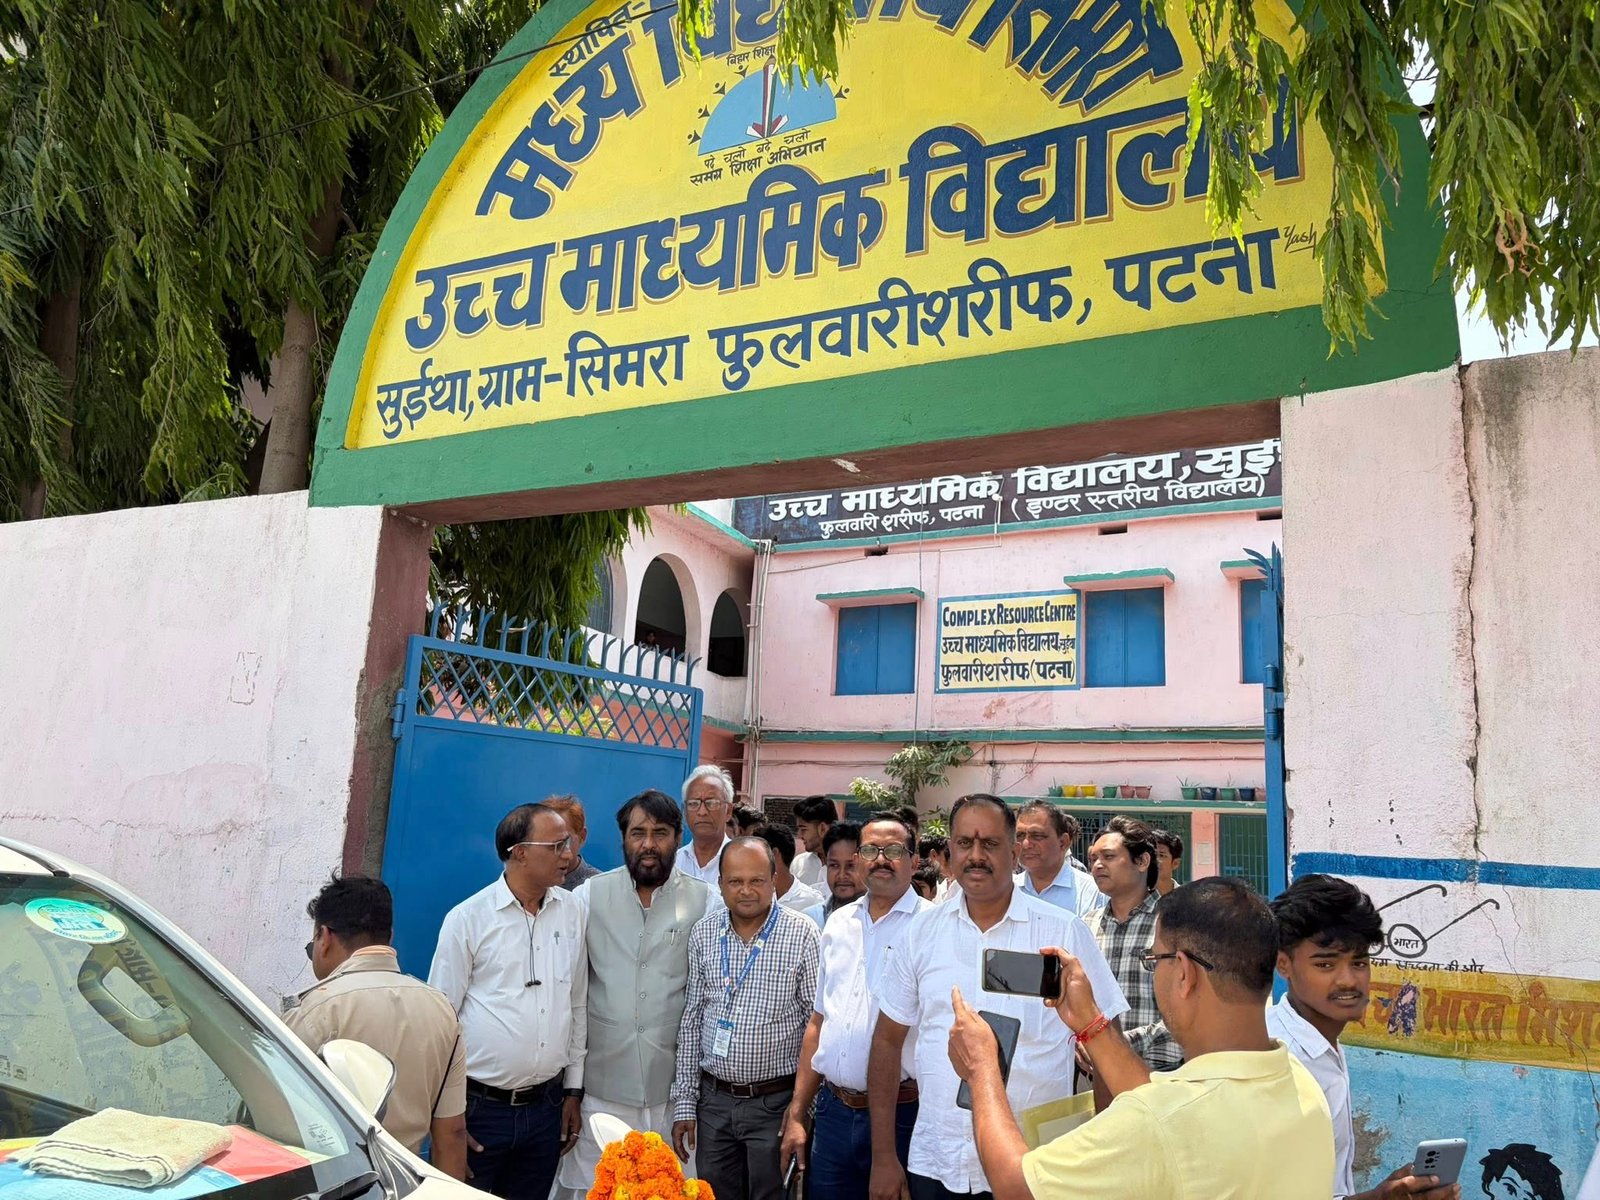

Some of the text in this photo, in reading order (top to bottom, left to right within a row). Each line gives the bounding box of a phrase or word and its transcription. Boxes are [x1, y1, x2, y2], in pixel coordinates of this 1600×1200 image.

[475, 31, 645, 221] मध्य
[723, 146, 747, 163] चलो
[784, 128, 811, 145] चलो
[729, 156, 763, 176] शिक्षा
[767, 138, 827, 165] अभियान
[404, 241, 557, 352] उच्च
[559, 164, 888, 316] माध्यमिक
[1283, 222, 1317, 260] Yash
[1104, 226, 1281, 312] पटना
[768, 494, 833, 522] उच्च
[841, 475, 1003, 512] माध्यमिक
[939, 504, 986, 522] पटना
[941, 636, 964, 655] उच्च
[965, 629, 1017, 654] माध्यमिक
[1393, 937, 1421, 949] भारत
[1461, 958, 1485, 974] ओर
[1422, 987, 1513, 1042] भारत
